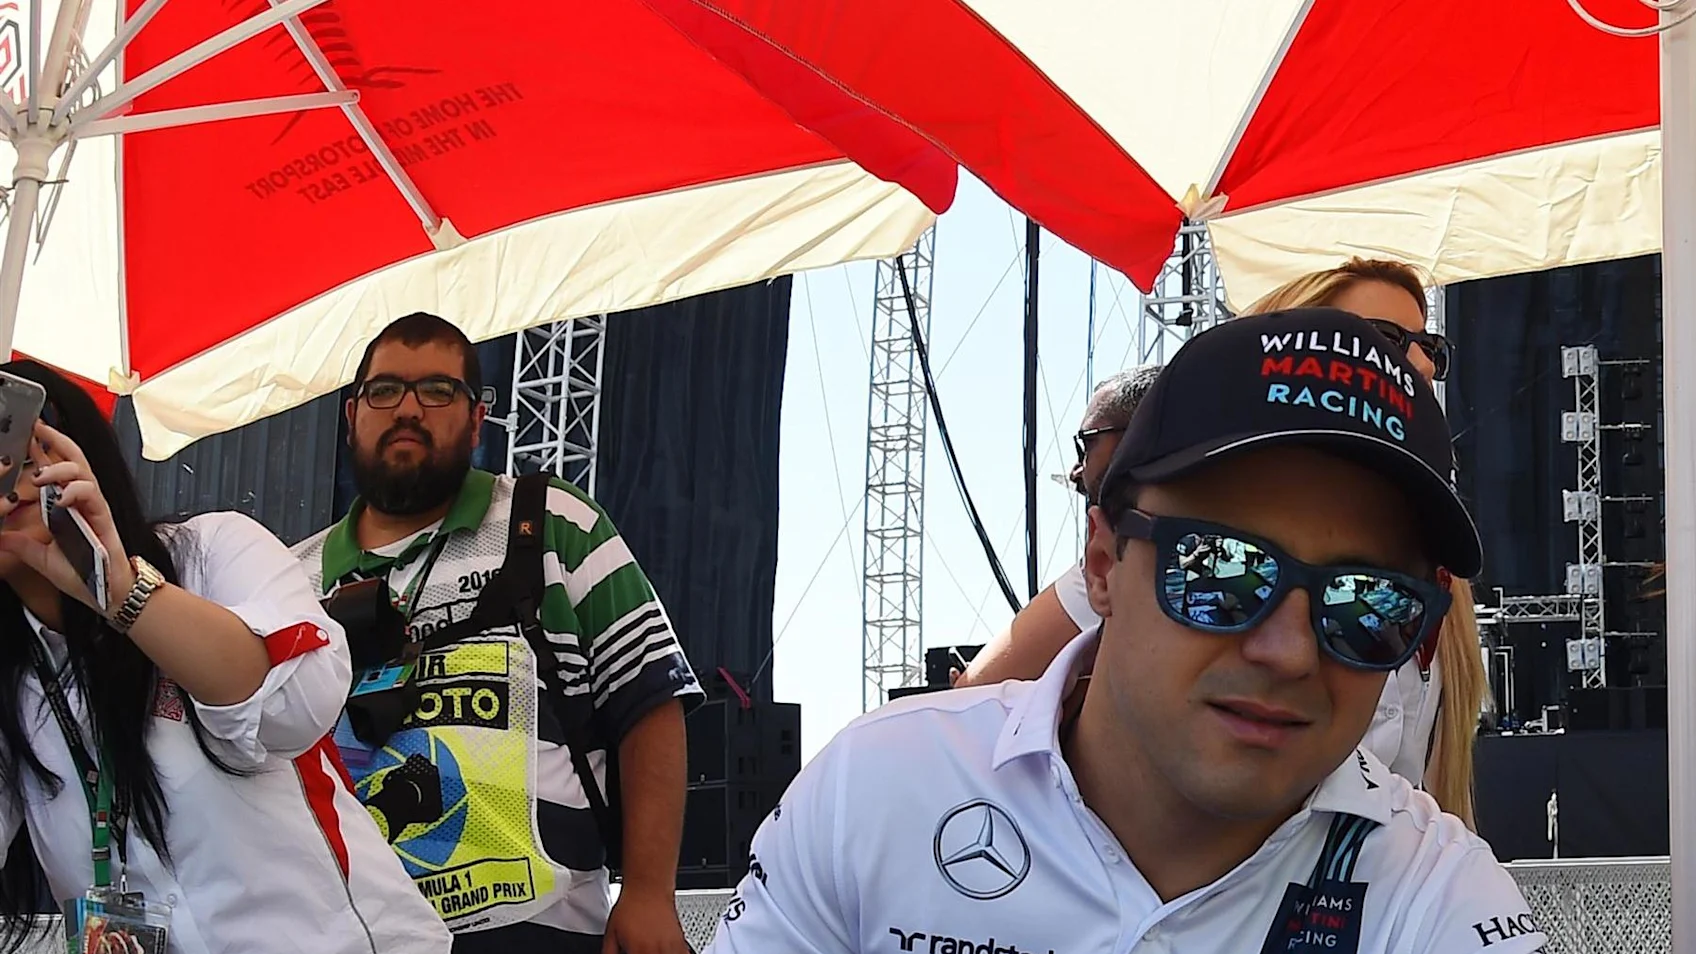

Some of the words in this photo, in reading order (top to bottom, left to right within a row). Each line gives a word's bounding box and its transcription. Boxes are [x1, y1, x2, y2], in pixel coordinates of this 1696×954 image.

[1260, 331, 1415, 398] WILLIAMS
[1260, 356, 1413, 419] MARTINI
[1266, 383, 1405, 442] RACING
[403, 686, 501, 725] OTO
[418, 874, 462, 899] MULA
[464, 870, 472, 887] 1
[441, 886, 489, 914] GRAND
[492, 882, 527, 898] PRIX
